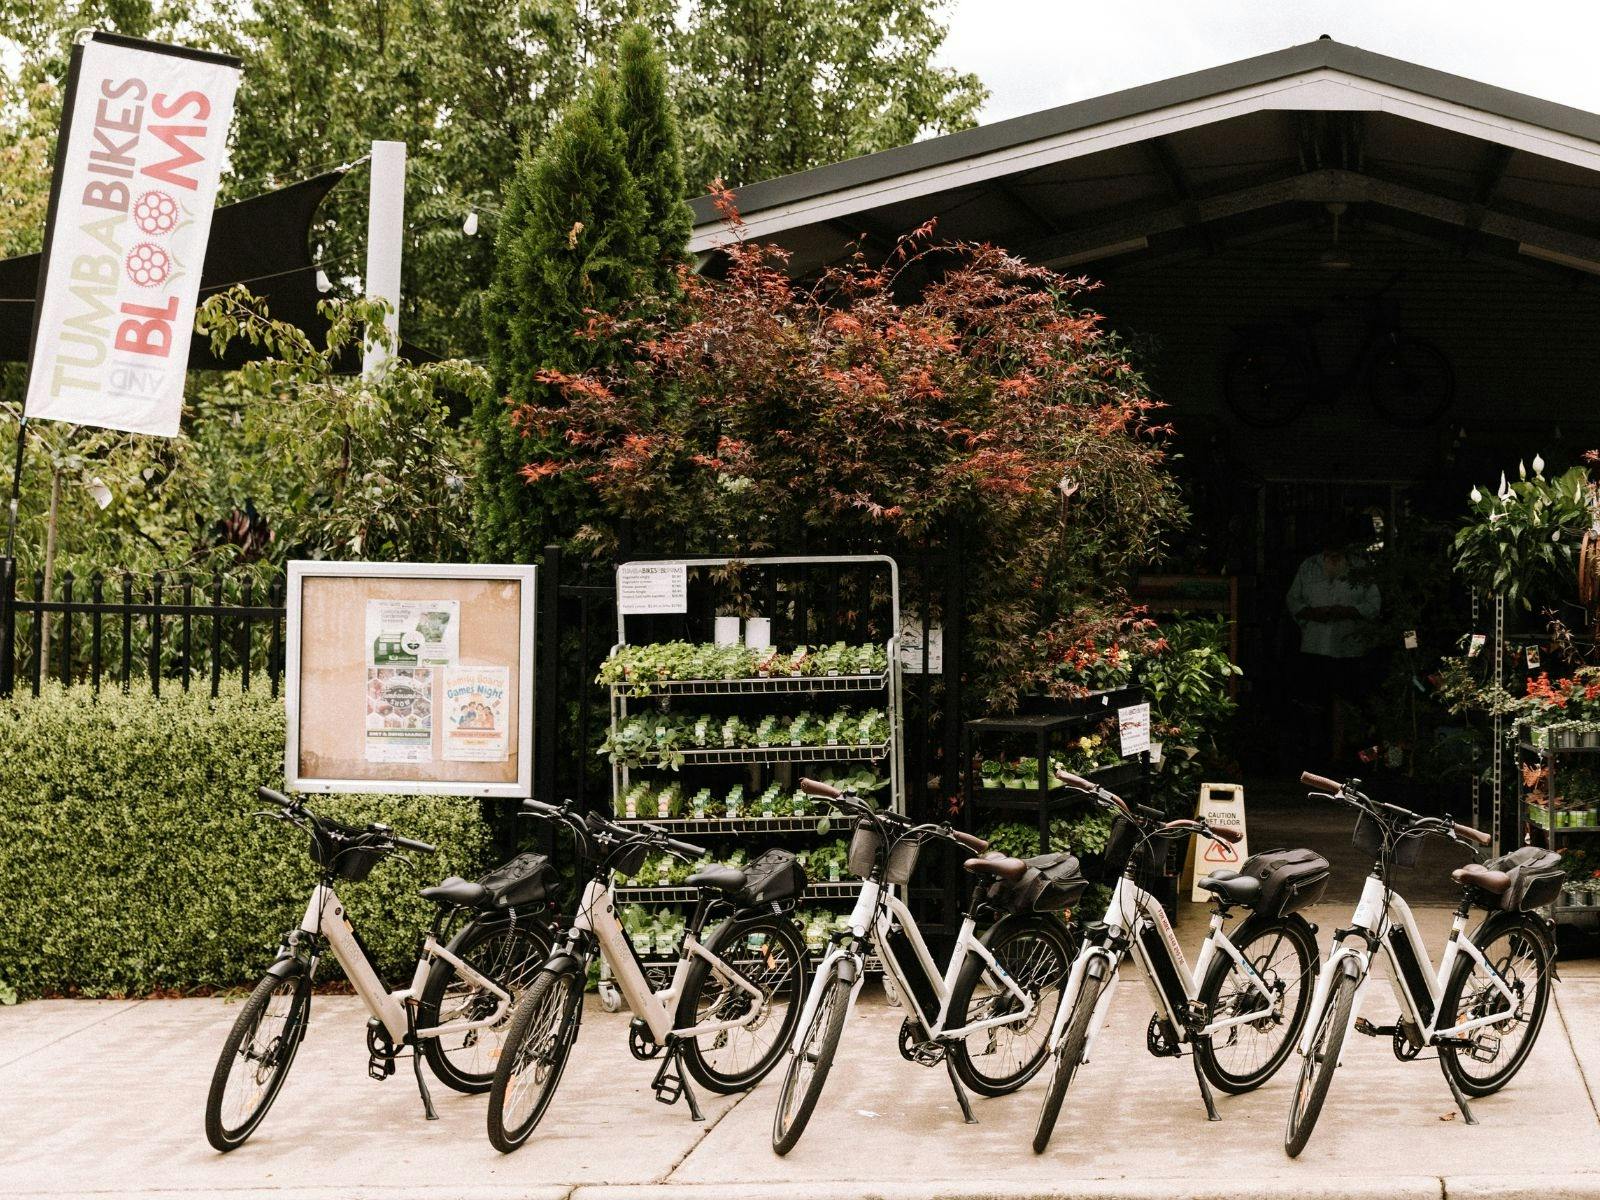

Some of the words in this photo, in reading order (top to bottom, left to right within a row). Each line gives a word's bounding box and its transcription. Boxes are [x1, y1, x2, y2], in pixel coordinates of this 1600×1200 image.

[82, 77, 148, 213] BIKES
[51, 214, 130, 399] TUMBA
[447, 686, 474, 699] Games
[477, 684, 503, 699] Night
[1207, 811, 1237, 820] CAUTION
